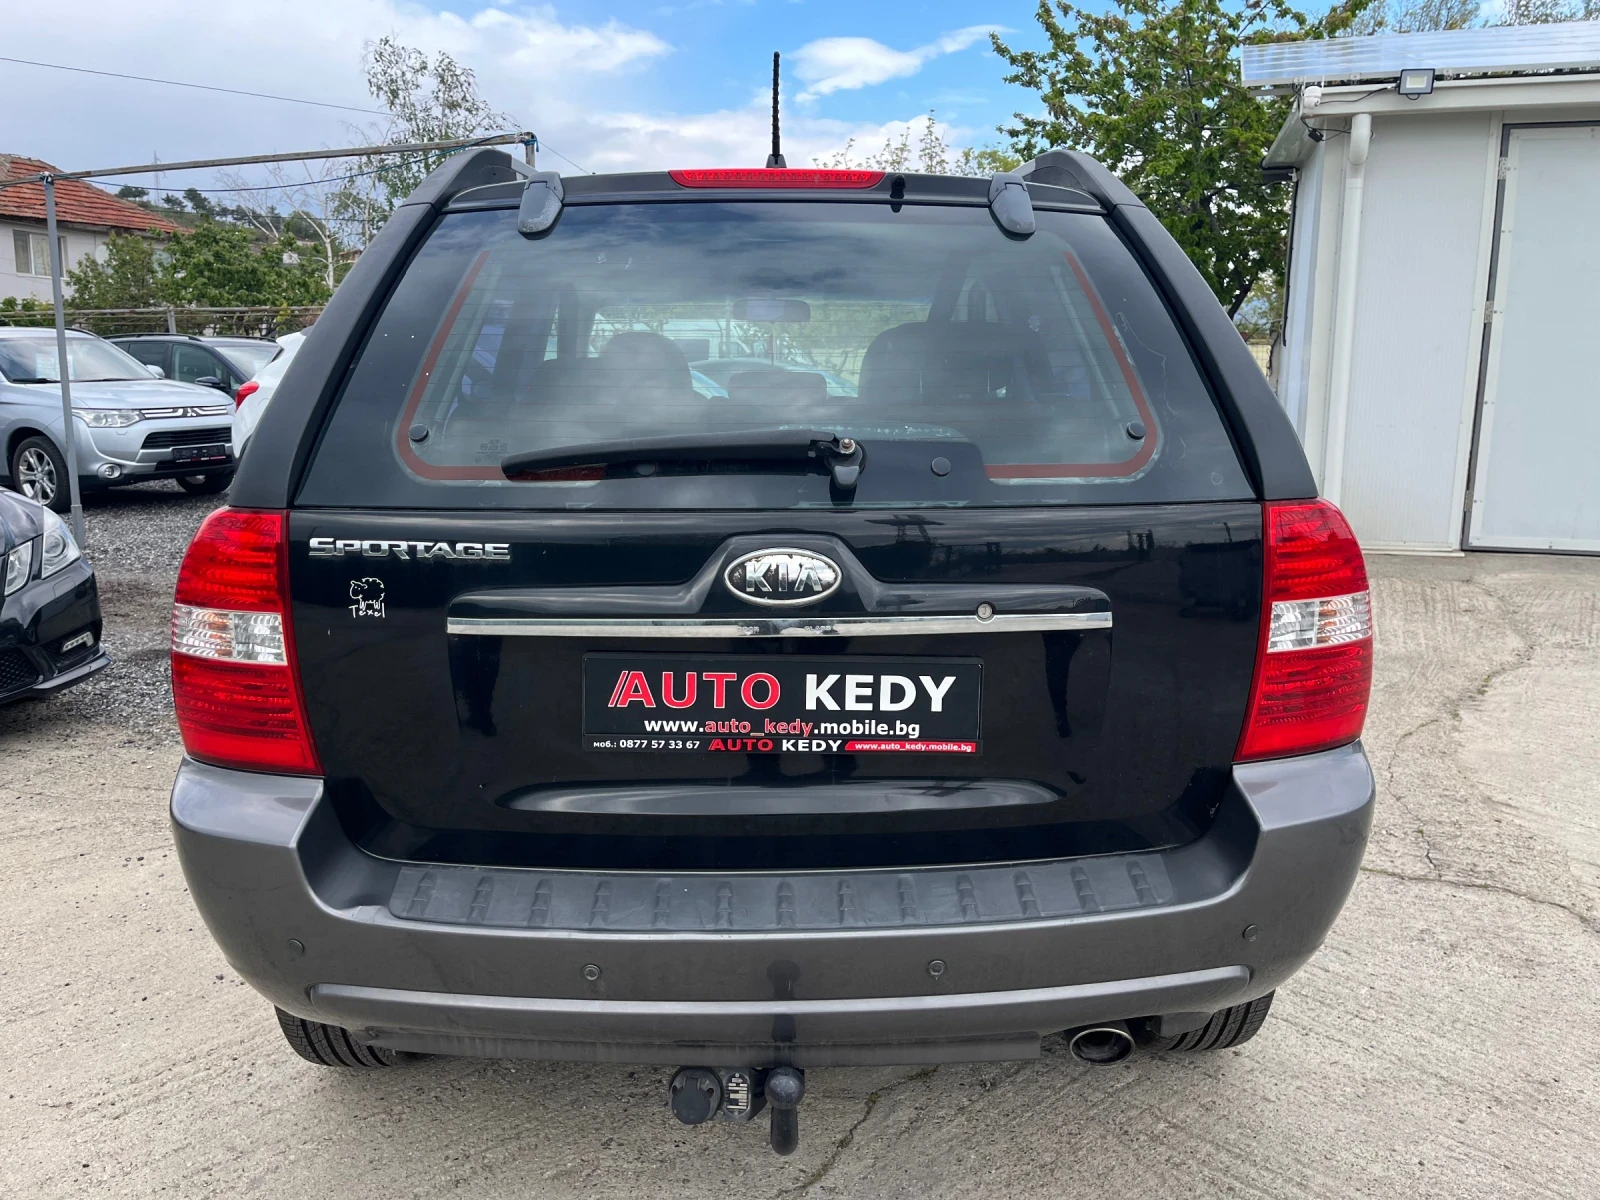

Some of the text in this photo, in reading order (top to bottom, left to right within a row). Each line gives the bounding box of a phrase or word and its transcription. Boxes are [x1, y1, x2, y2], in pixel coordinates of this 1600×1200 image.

[744, 562, 823, 592] KIA
[348, 603, 386, 618] Texel
[607, 670, 957, 712] AUTO KEDY
[644, 718, 920, 738] www.auto_kedy.mobile.bg
[619, 739, 648, 749] 0877
[651, 740, 666, 749] 57
[668, 740, 683, 749] 33
[686, 740, 700, 749] 67
[708, 738, 774, 751] AUTO
[782, 739, 842, 751] KEDY
[855, 741, 972, 753] www.auto_kedy.mobile.bg
